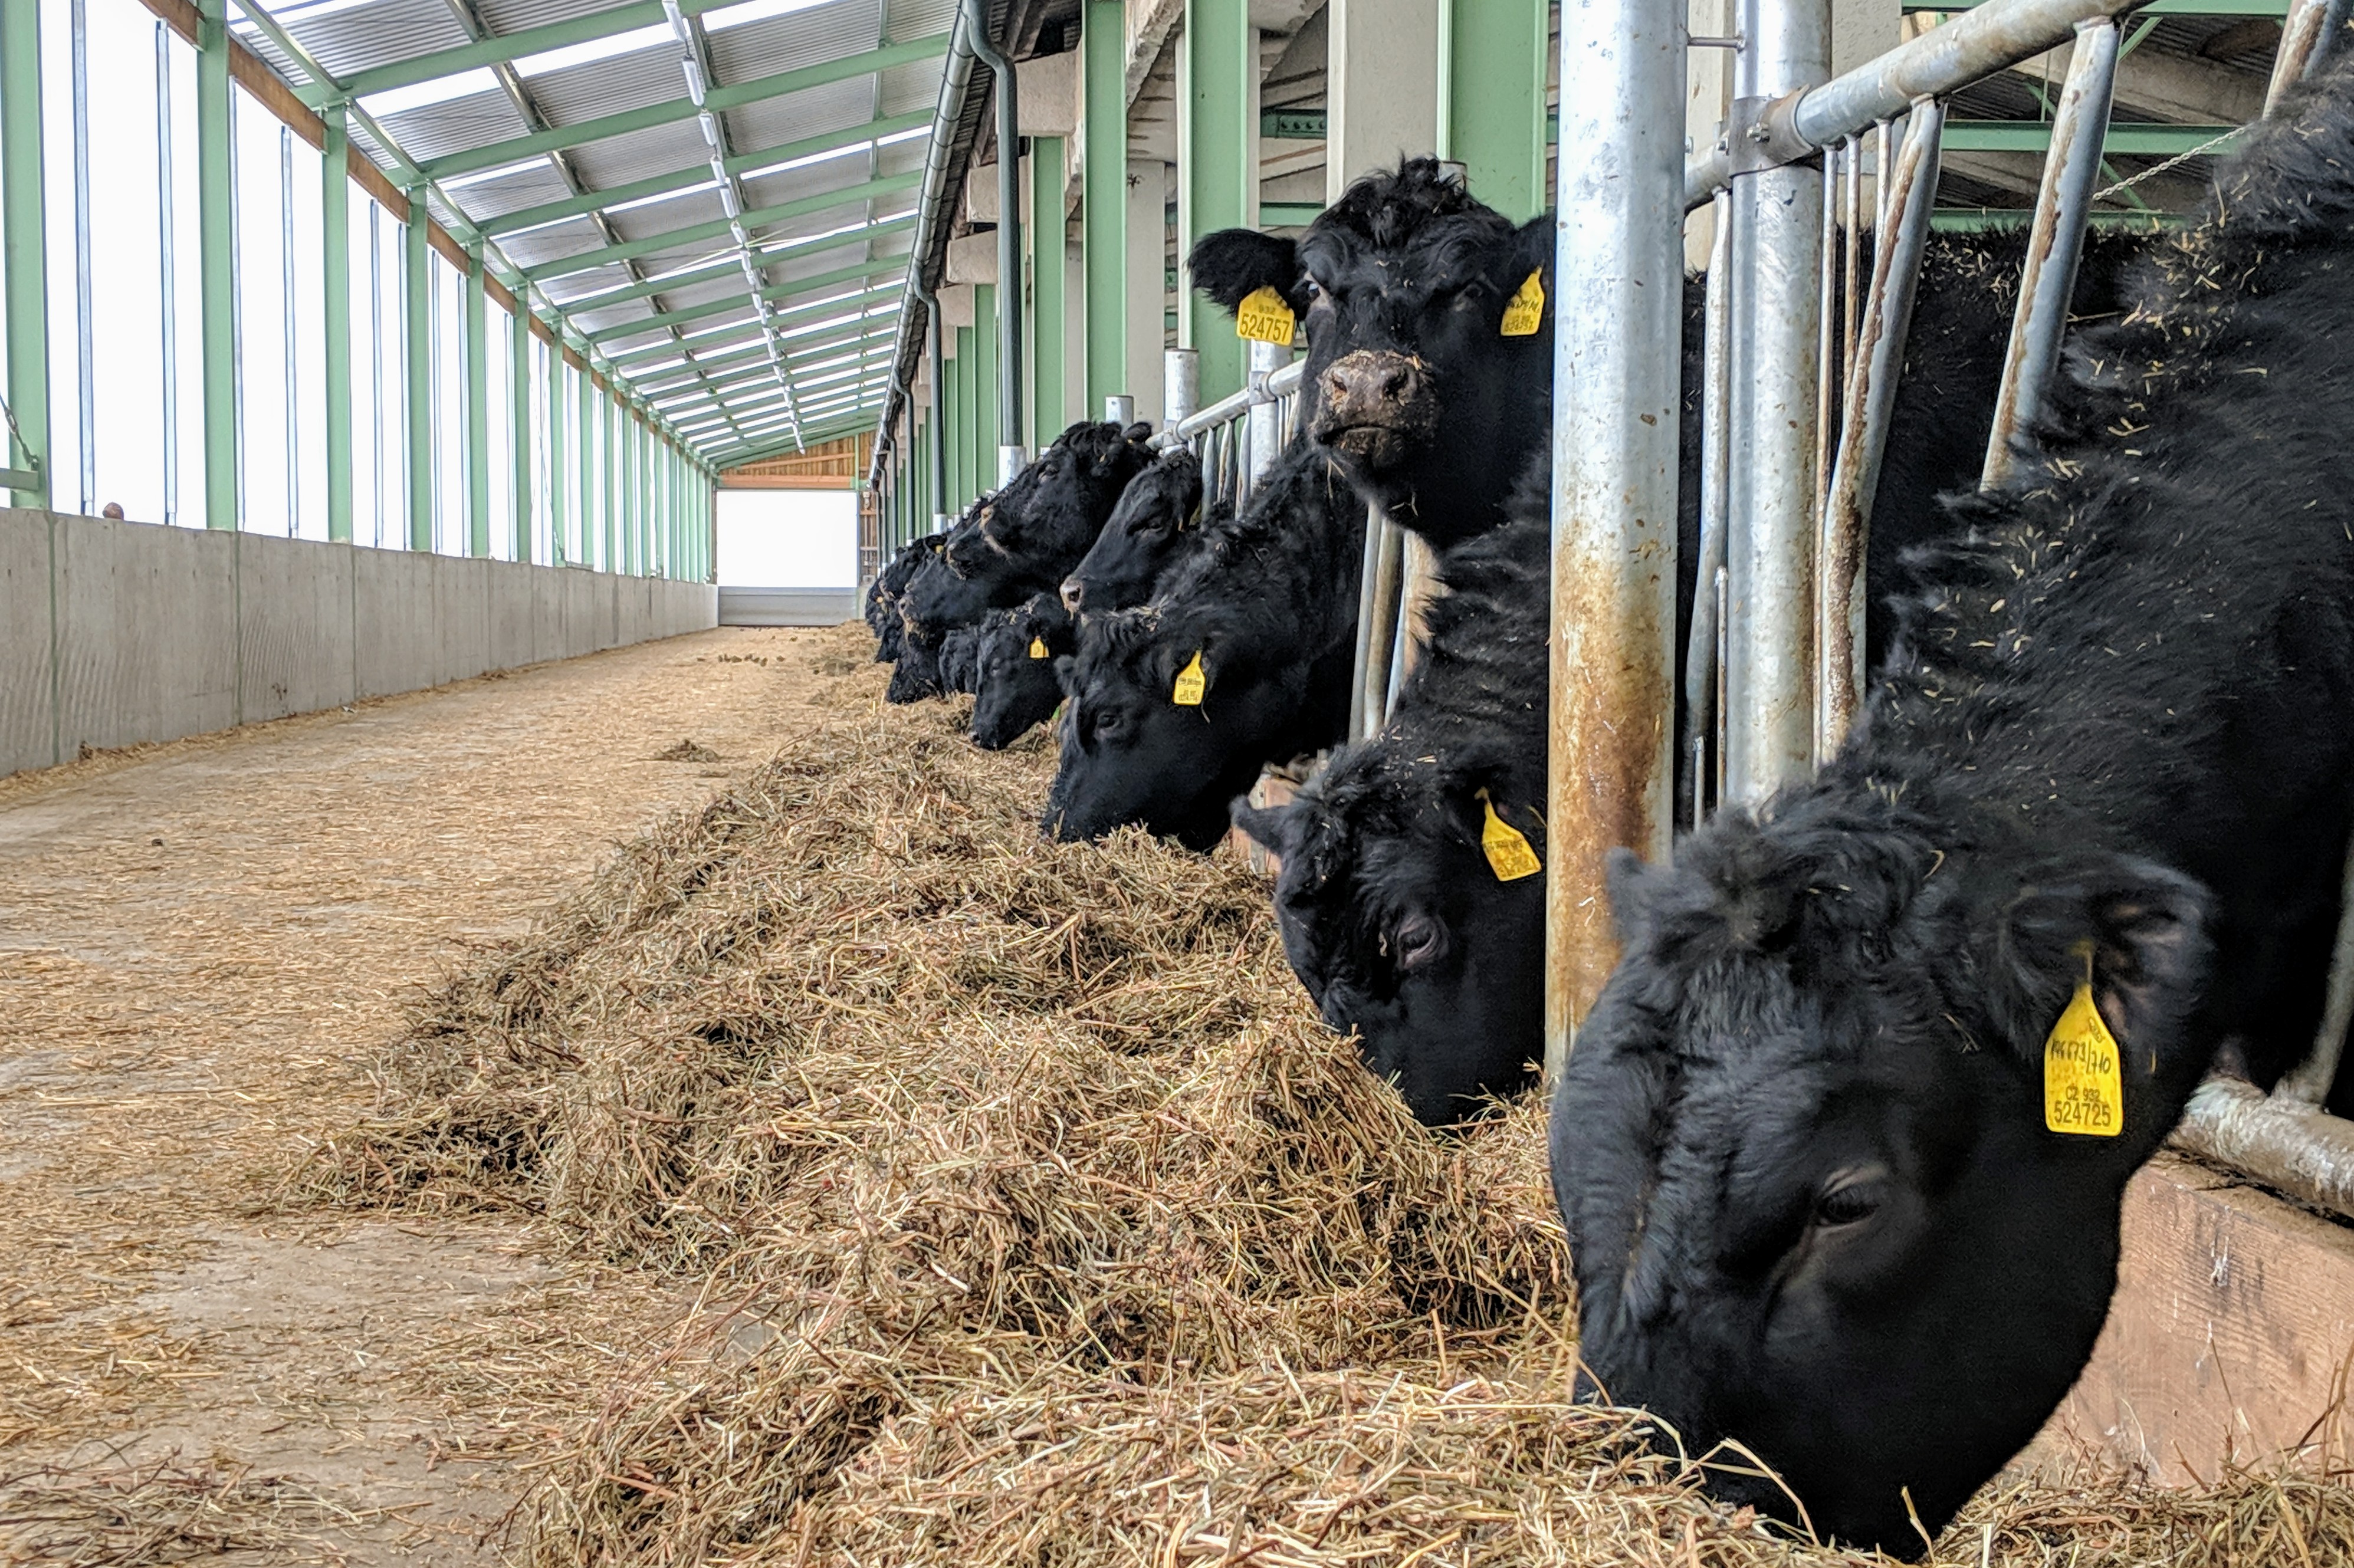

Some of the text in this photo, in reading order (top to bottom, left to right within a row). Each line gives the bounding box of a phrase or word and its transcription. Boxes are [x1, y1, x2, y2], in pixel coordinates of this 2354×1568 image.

[1240, 313, 1290, 342] 524757
[2083, 1087, 2100, 1102] 932
[2054, 1100, 2111, 1127] 524725
